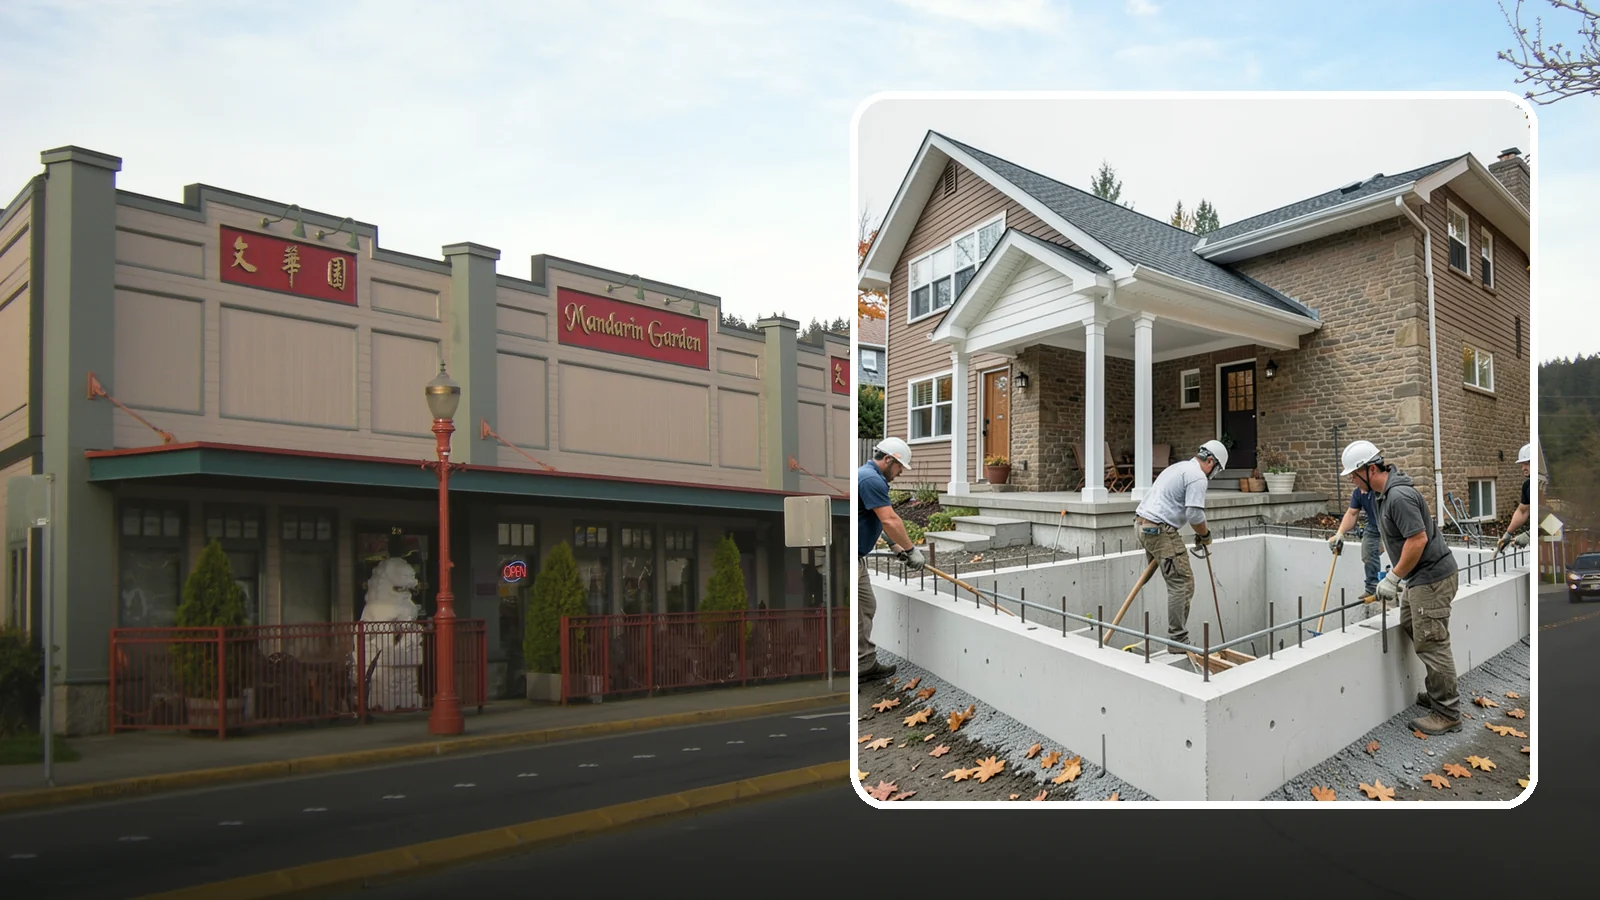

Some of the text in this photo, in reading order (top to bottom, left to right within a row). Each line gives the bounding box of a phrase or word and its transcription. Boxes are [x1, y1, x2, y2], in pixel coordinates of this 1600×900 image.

[231, 236, 346, 291] 文華園
[565, 302, 701, 352] Mandarin Garden
[835, 363, 846, 386] 文
[503, 565, 527, 578] OPEN
